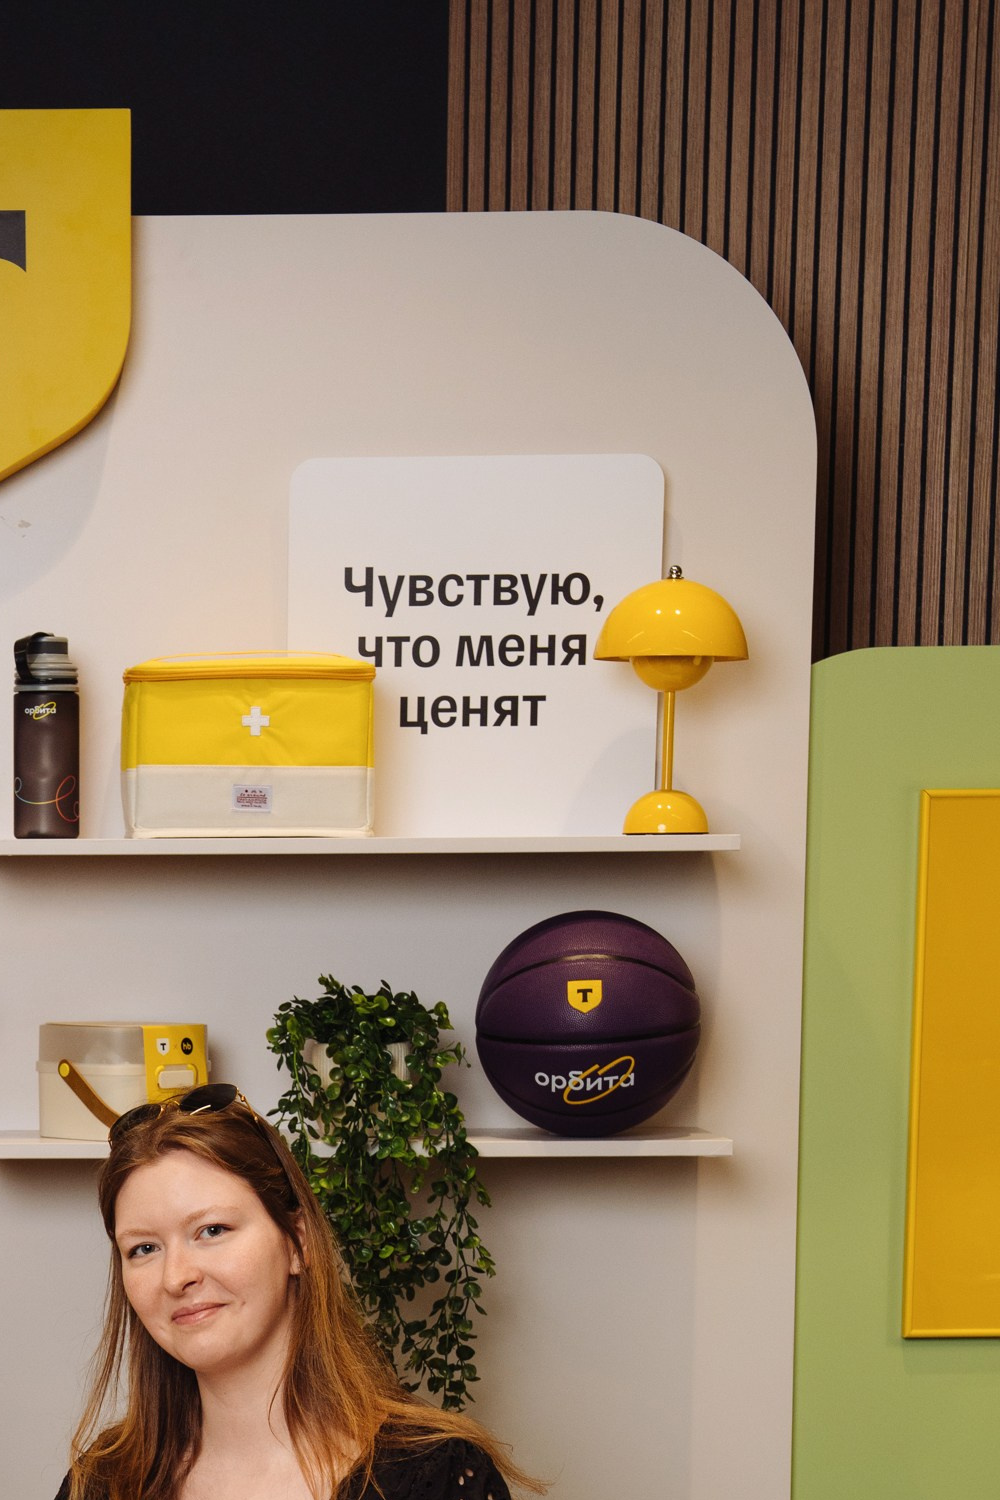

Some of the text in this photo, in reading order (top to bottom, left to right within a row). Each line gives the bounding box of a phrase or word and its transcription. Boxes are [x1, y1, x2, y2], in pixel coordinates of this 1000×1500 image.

[344, 566, 604, 618] Чувствую,
[358, 634, 588, 668] что меня
[399, 695, 548, 735] ценят
[534, 1062, 636, 1099] орбита
